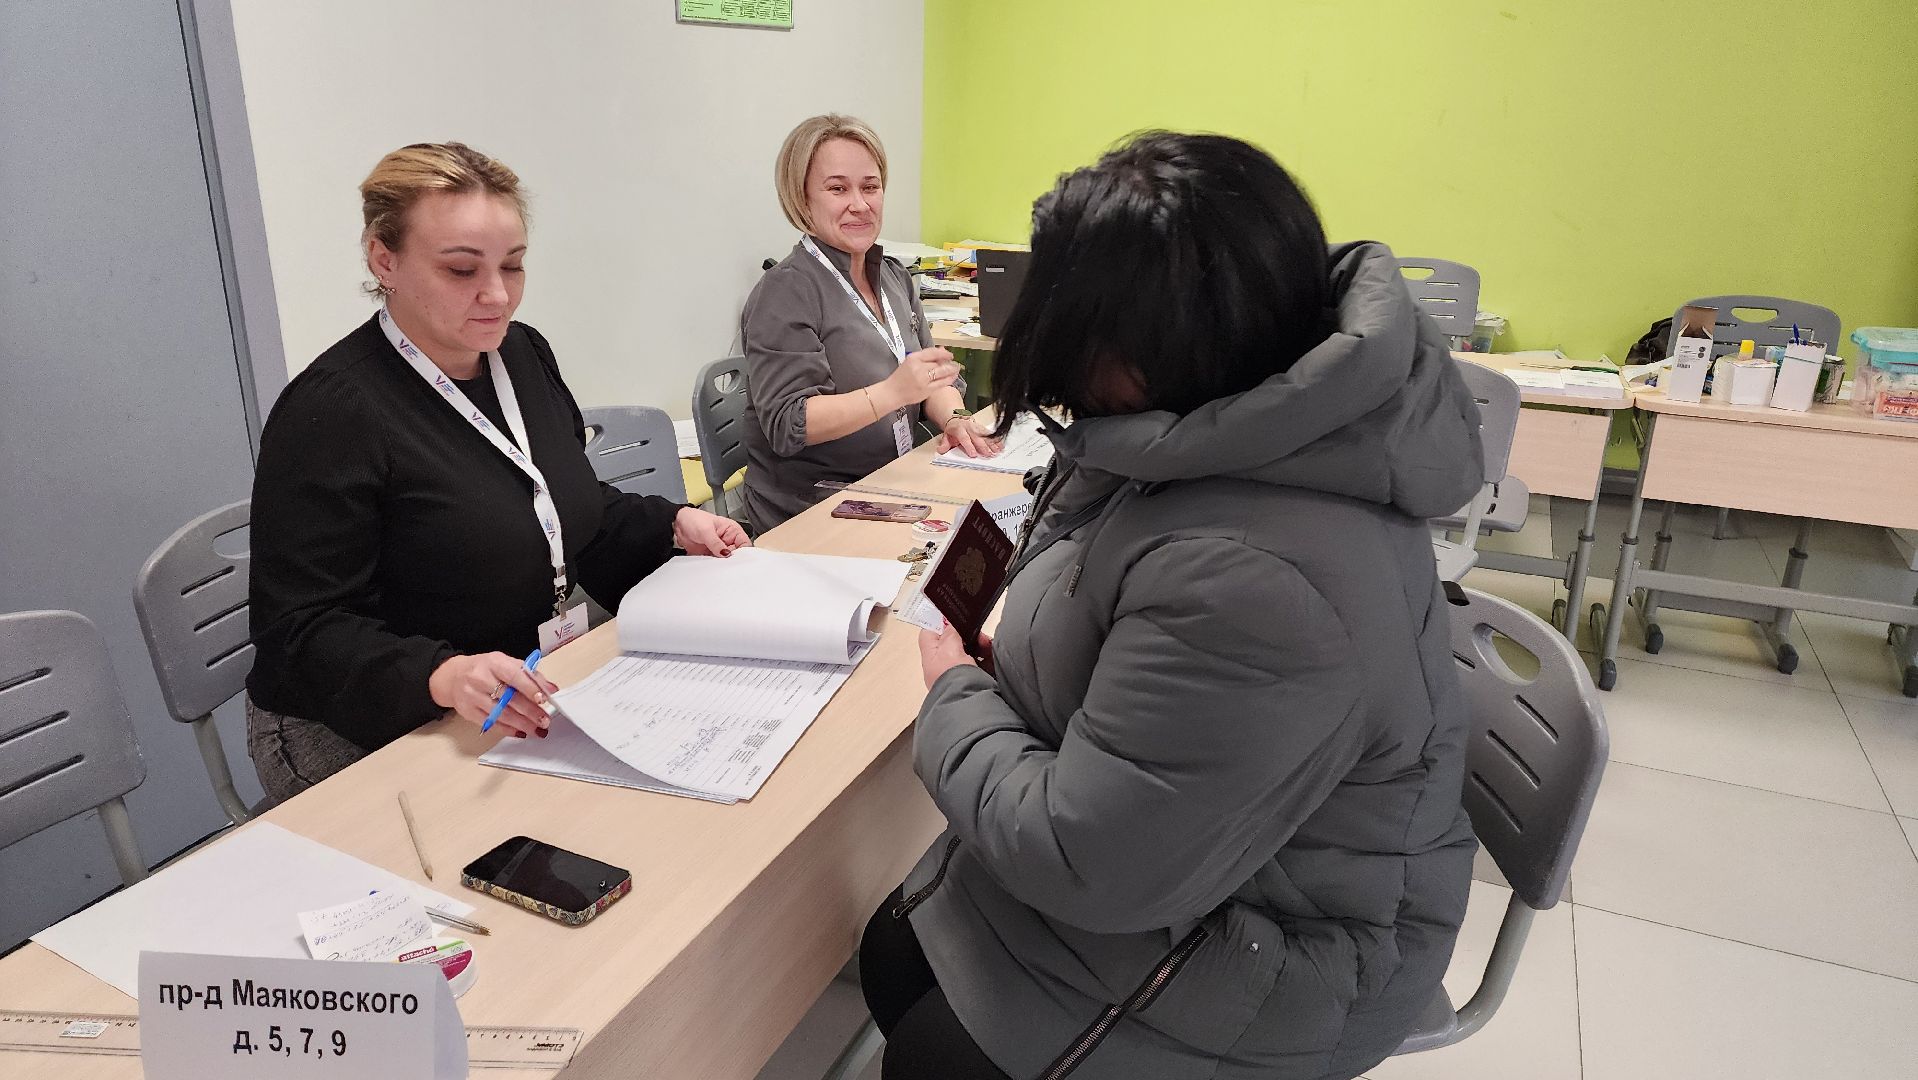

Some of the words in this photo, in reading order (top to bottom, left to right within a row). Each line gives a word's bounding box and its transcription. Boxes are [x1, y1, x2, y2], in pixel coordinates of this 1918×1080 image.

[160, 985, 222, 1010] пр-д
[233, 979, 418, 1014] Маяковского
[233, 1031, 258, 1054] д.
[269, 1026, 290, 1057] 5,
[300, 1028, 322, 1059] 7,
[332, 1030, 346, 1056] 9
